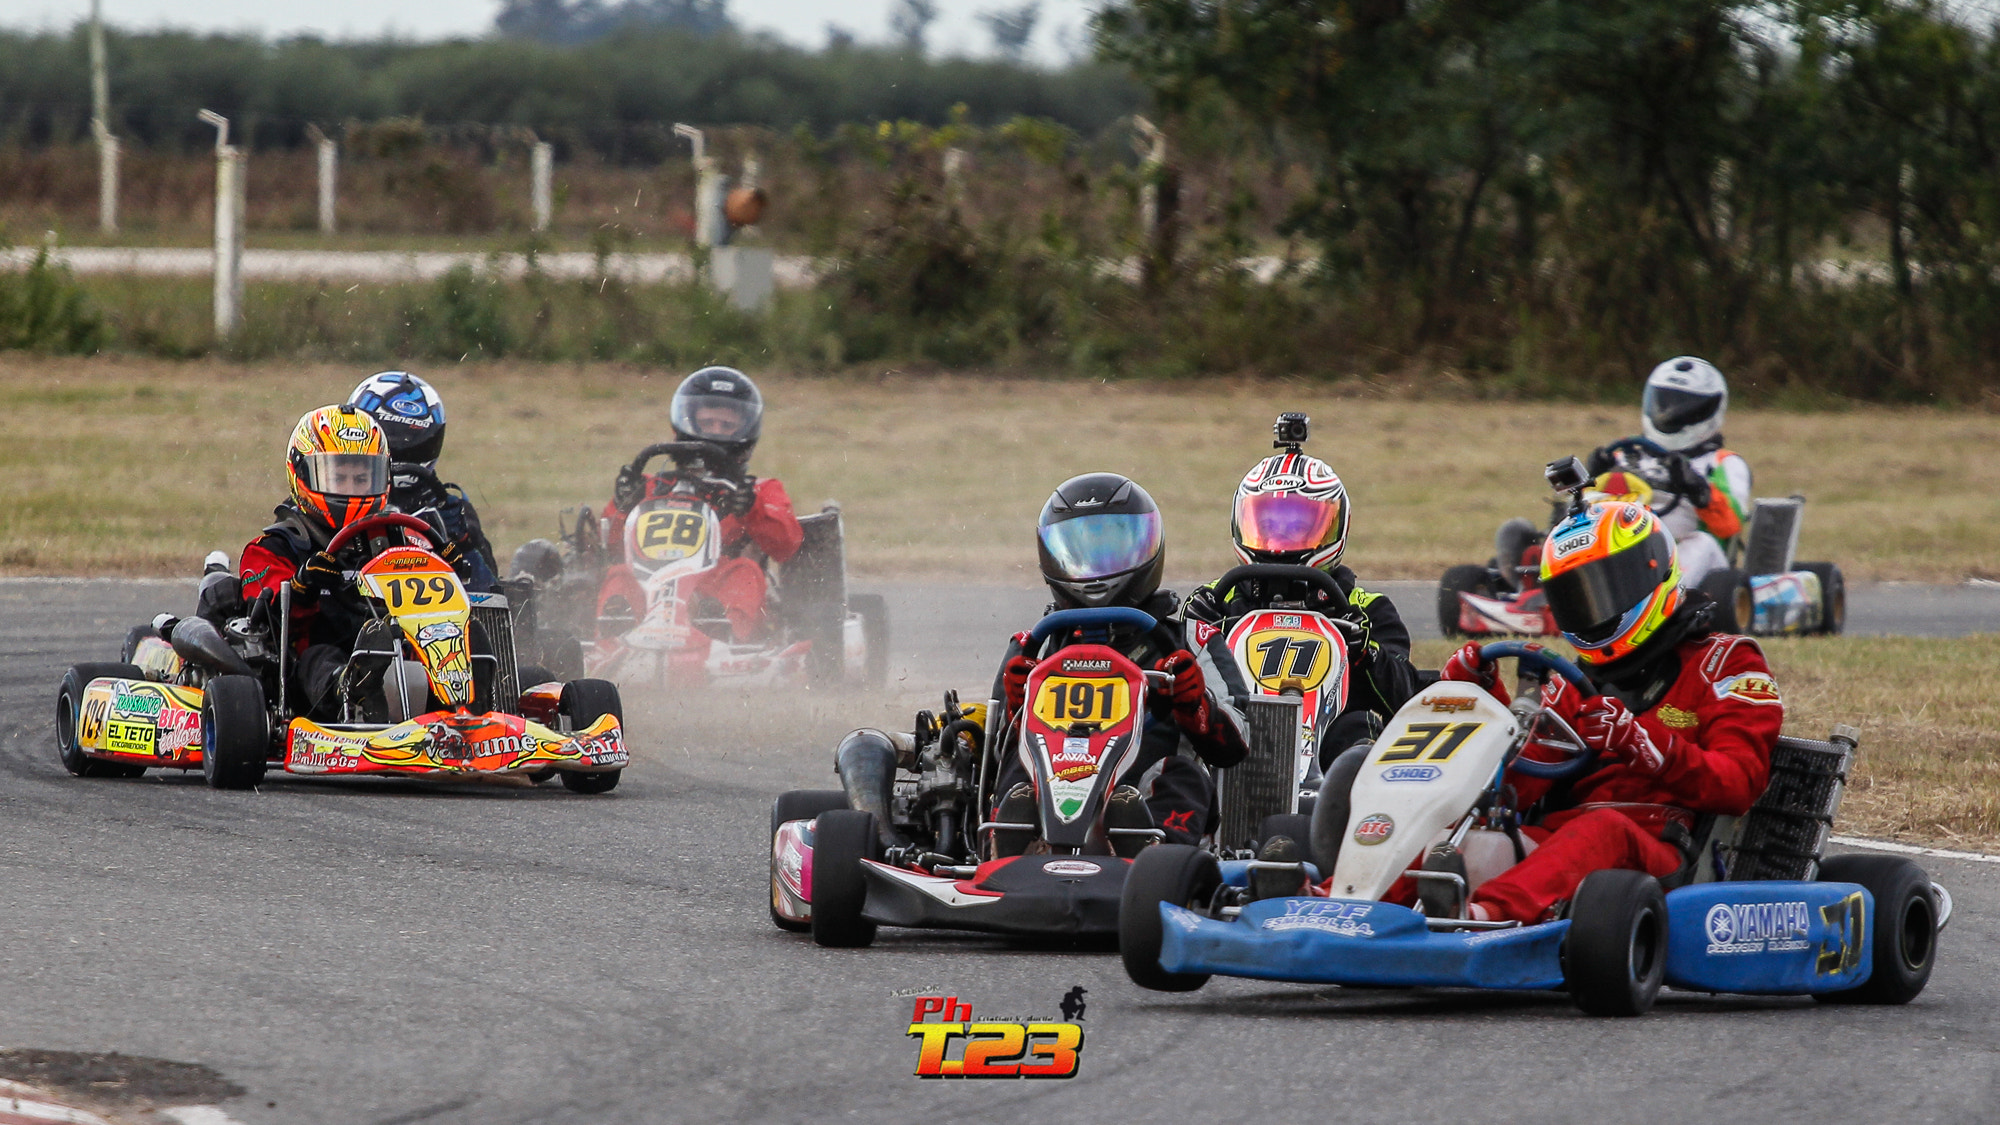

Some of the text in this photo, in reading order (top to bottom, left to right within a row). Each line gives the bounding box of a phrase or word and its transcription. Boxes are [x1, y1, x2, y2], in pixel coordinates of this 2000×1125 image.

[344, 428, 366, 438] Arai
[1262, 478, 1301, 488] SUOMY
[643, 513, 704, 548] 28
[1558, 534, 1591, 556] SHOEI
[386, 577, 455, 608] 129
[1275, 615, 1301, 625] RGB
[1073, 660, 1112, 669] MAKART
[1256, 637, 1324, 680] 11
[1049, 682, 1115, 719] 191
[108, 724, 154, 742] EL TETO
[1375, 722, 1487, 765] 31
[1052, 753, 1097, 764] KAWAK
[1390, 768, 1434, 779] SHOEI
[1357, 822, 1393, 835] ATC
[1285, 899, 1373, 919] YPF
[1733, 901, 1810, 942] YAMAHA
